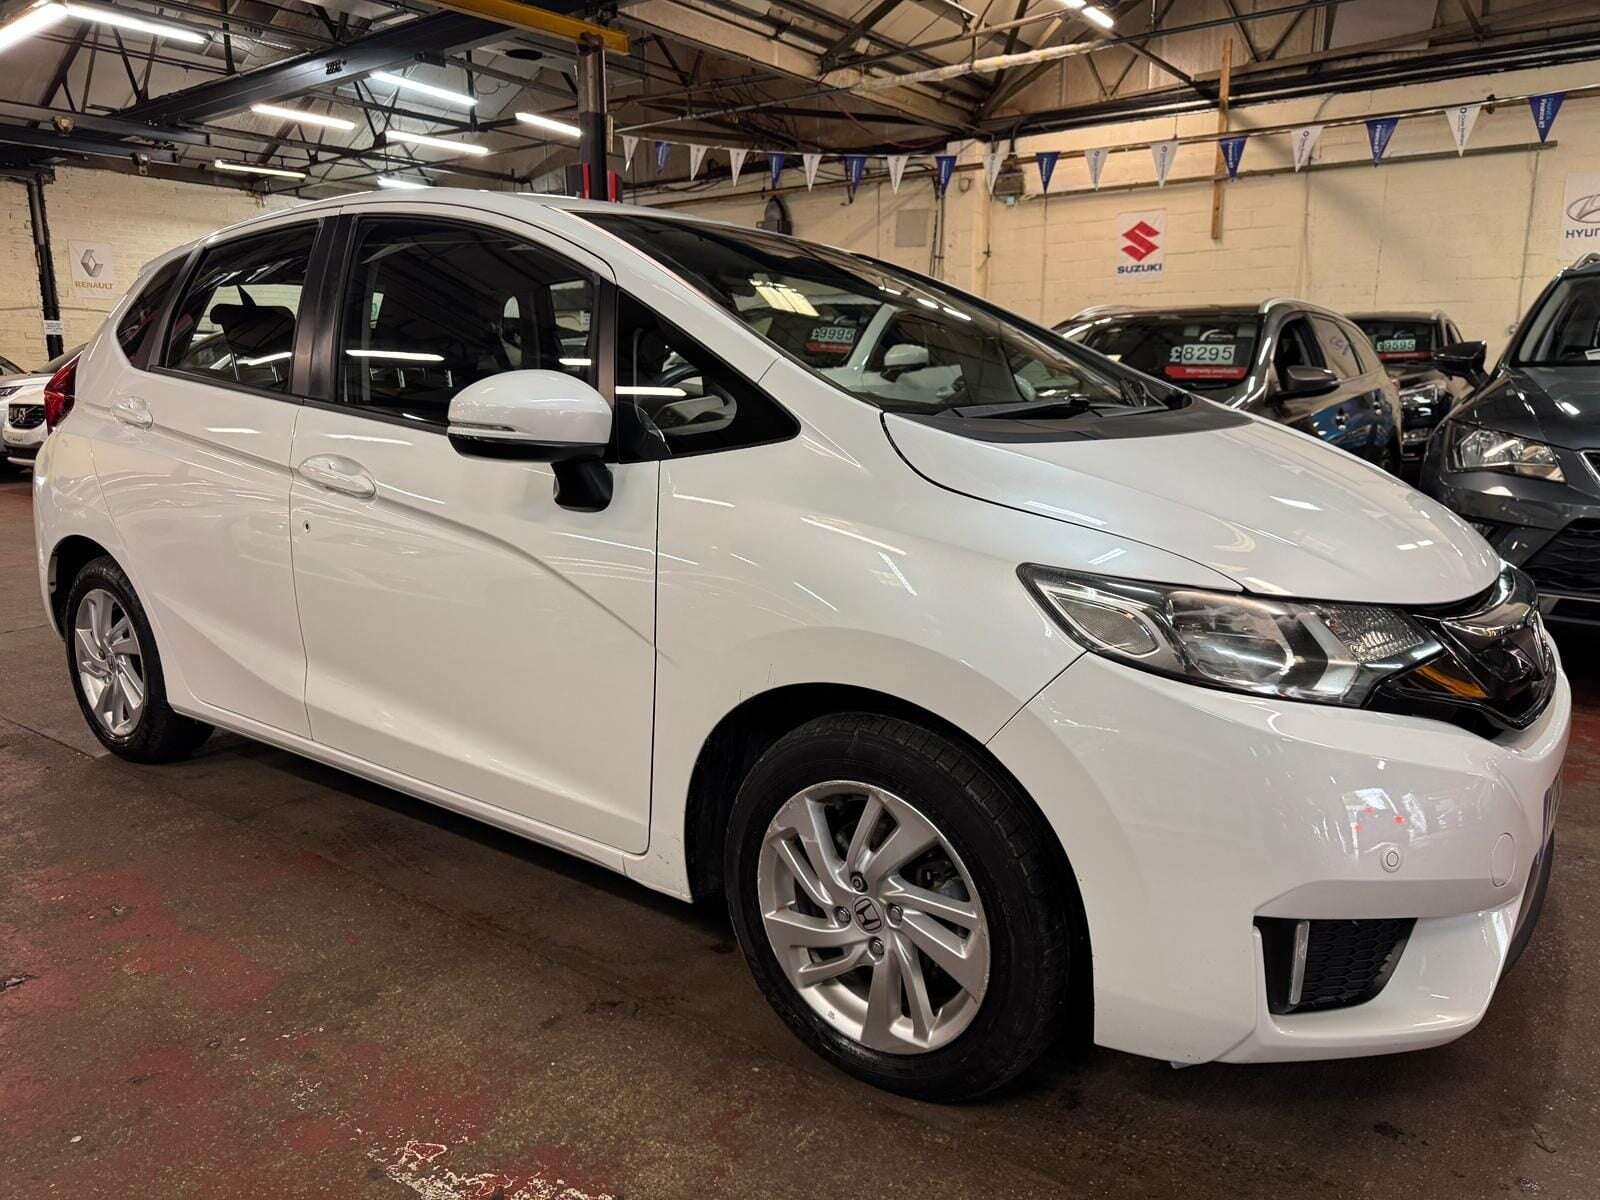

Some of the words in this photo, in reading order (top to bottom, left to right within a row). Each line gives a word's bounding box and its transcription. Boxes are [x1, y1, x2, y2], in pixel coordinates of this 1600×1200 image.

[1117, 263, 1162, 274] SUZUKI
[74, 281, 112, 289] RENAULT
[1169, 346, 1233, 362] £8295
